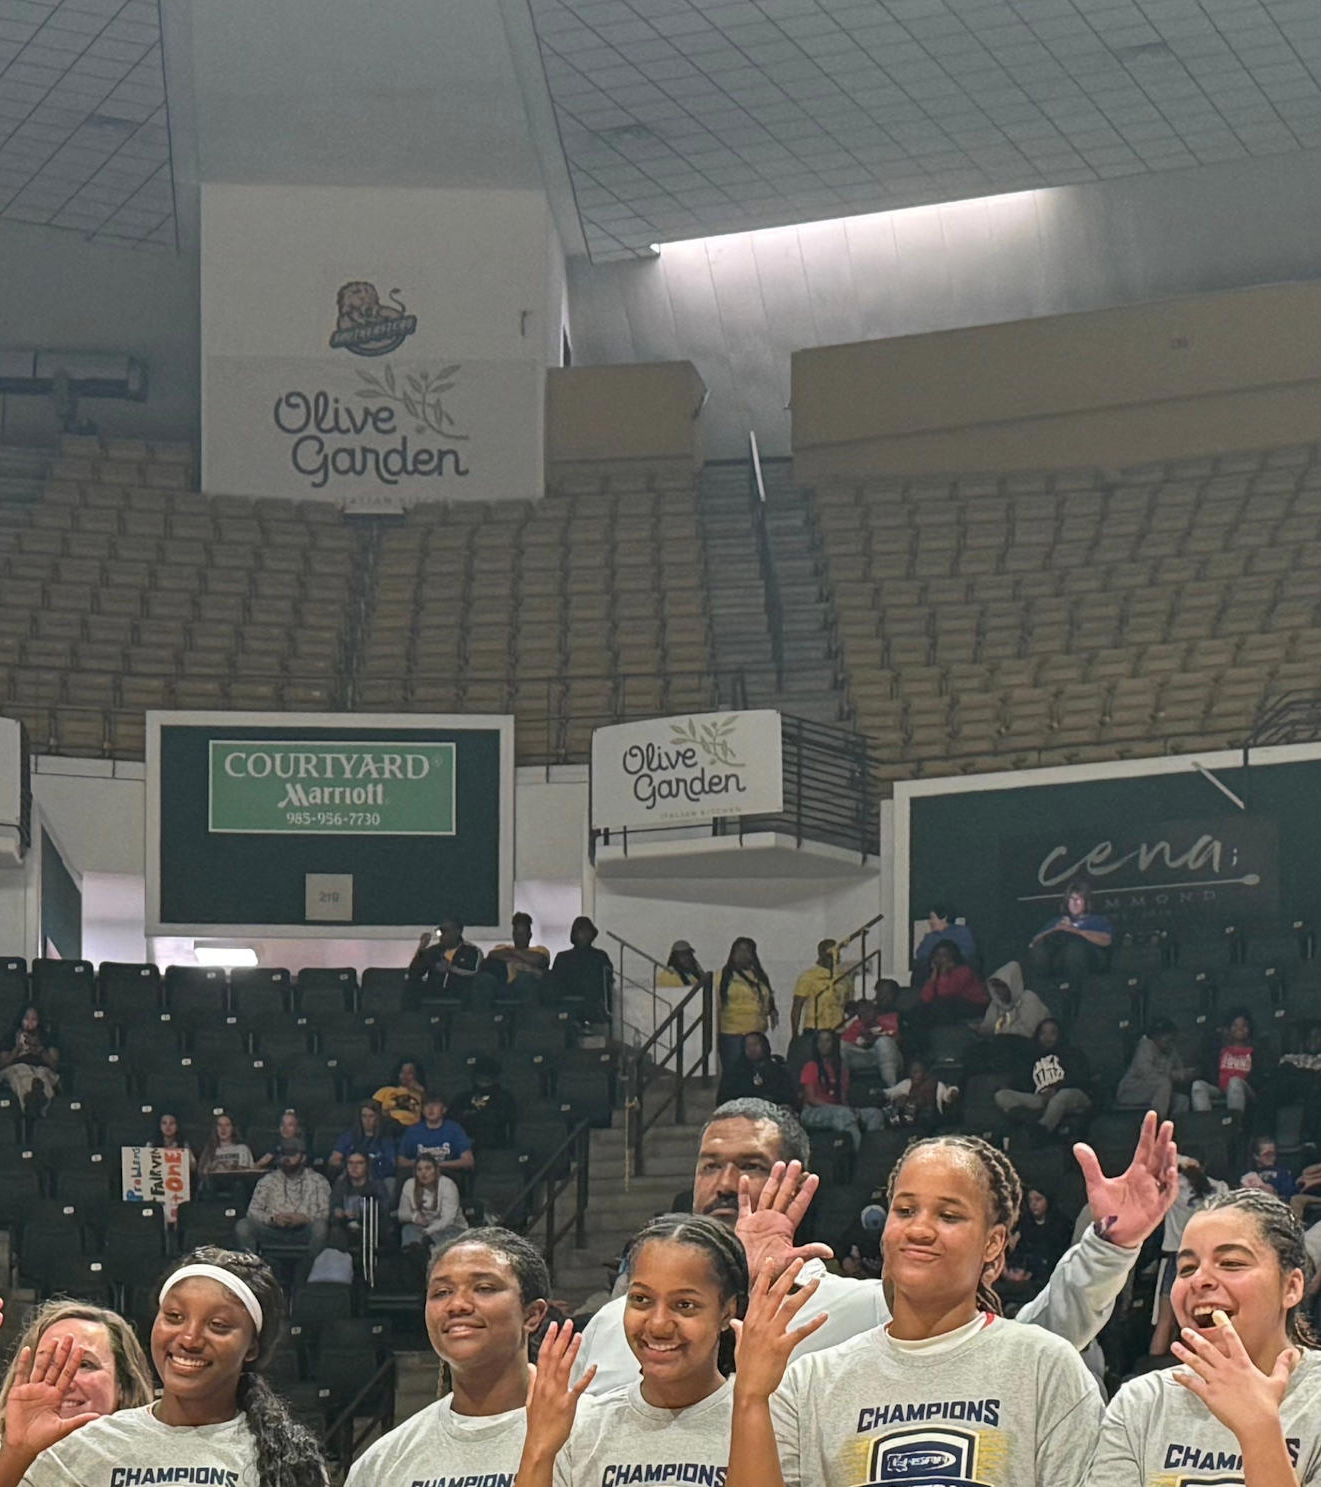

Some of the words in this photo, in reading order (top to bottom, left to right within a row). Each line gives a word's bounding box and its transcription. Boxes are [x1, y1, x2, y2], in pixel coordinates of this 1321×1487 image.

[274, 391, 397, 434] Olive
[292, 435, 469, 488] Garden
[224, 752, 430, 779] COURTYARD
[623, 742, 698, 775] Olive
[277, 783, 385, 809] Marriott
[634, 767, 747, 810] Garden
[286, 811, 382, 826] 985-956-7730
[857, 1398, 1000, 1433] CHAMPIONS
